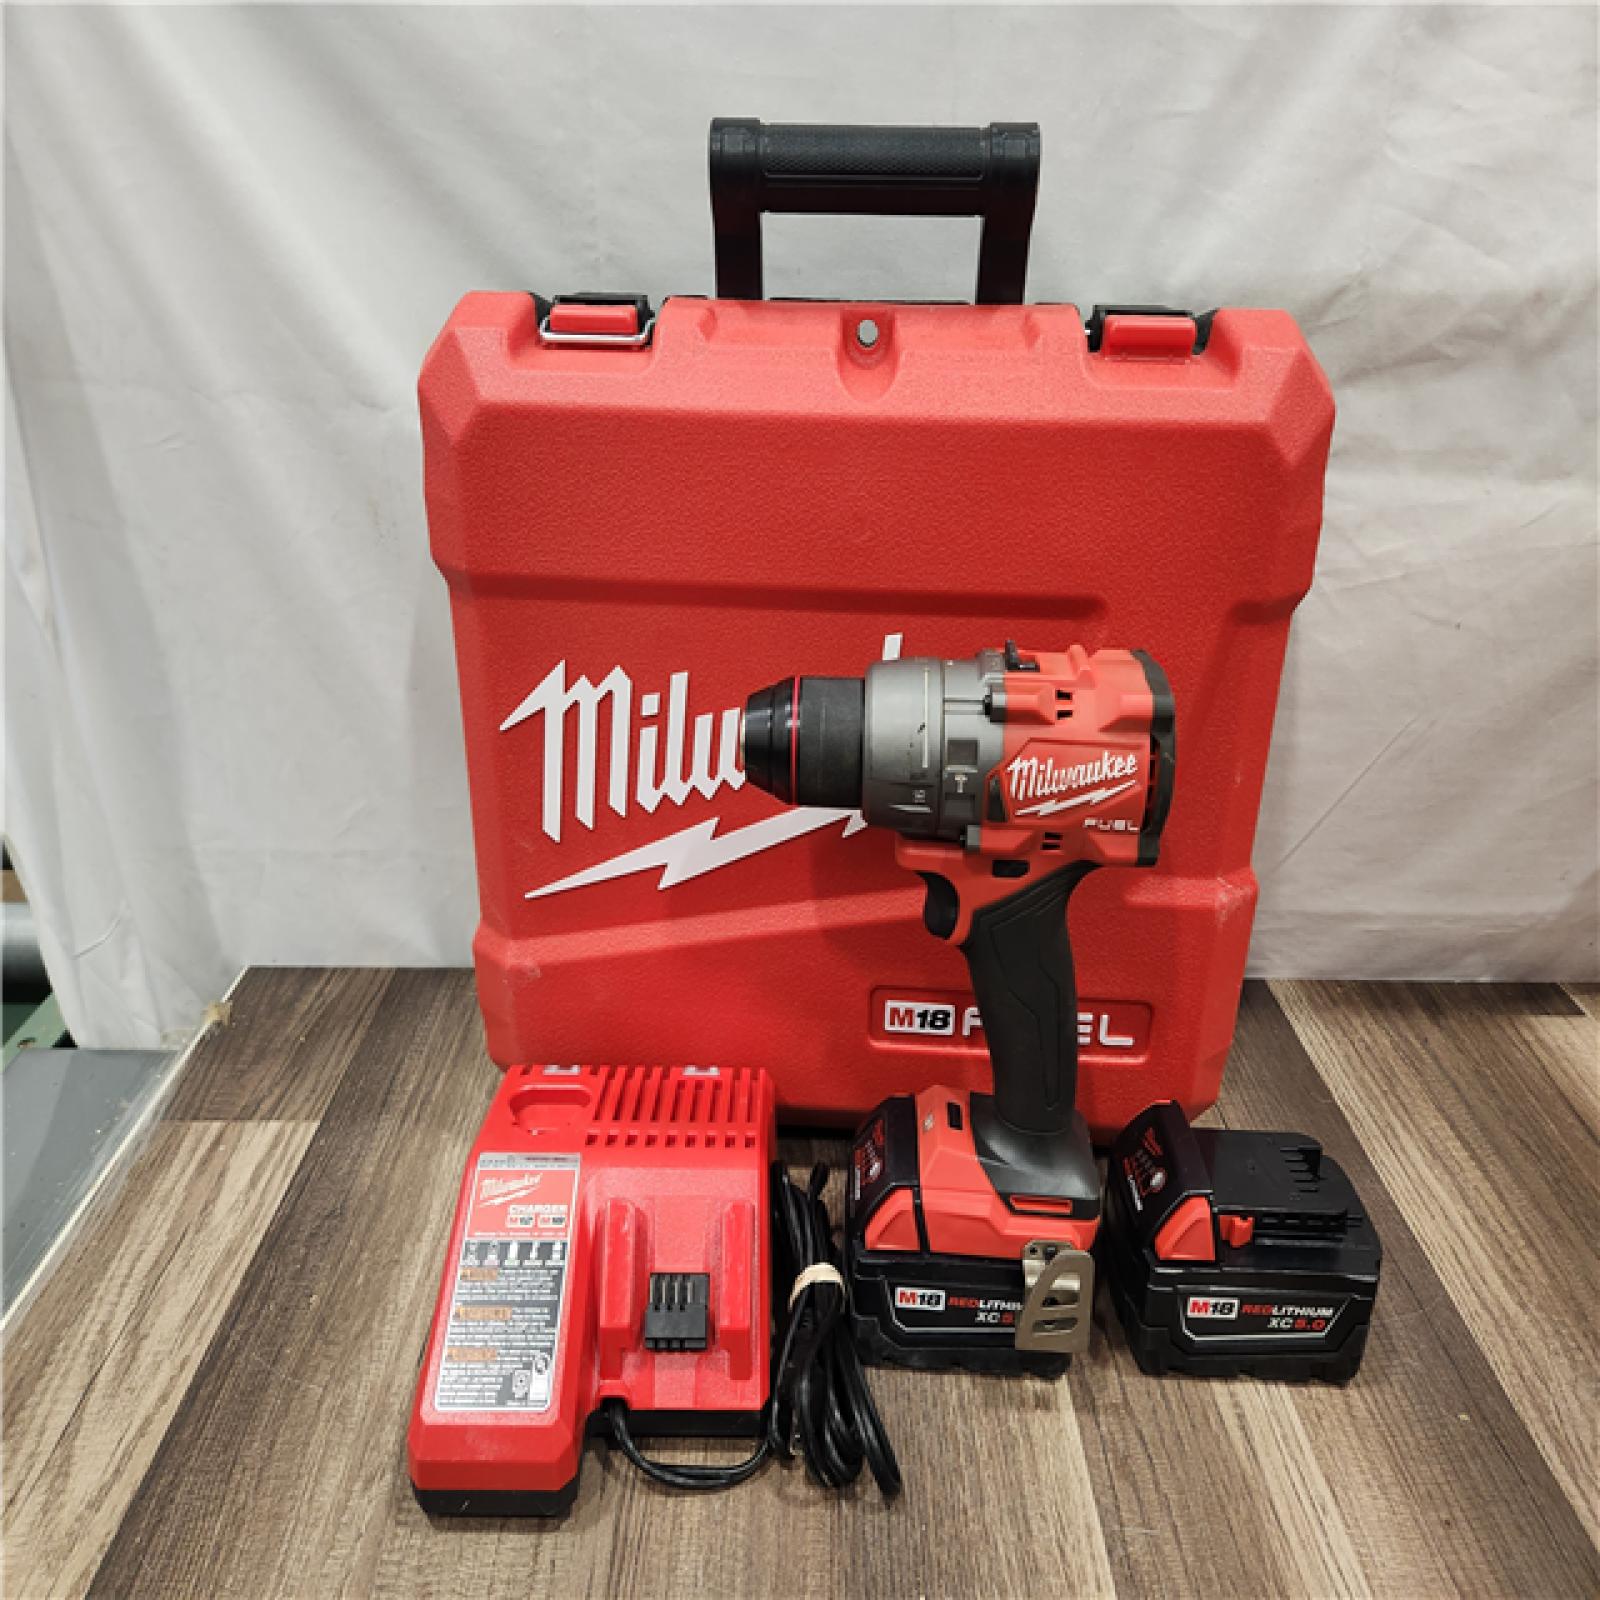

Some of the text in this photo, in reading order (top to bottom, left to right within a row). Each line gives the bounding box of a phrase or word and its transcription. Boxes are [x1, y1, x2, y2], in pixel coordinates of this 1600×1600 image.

[1007, 750, 1137, 800] Milwaukee
[1084, 817, 1139, 831] FUEL
[888, 1006, 1134, 1046] M18 FEL
[898, 1290, 942, 1307] M18
[1189, 1300, 1236, 1316] M18
